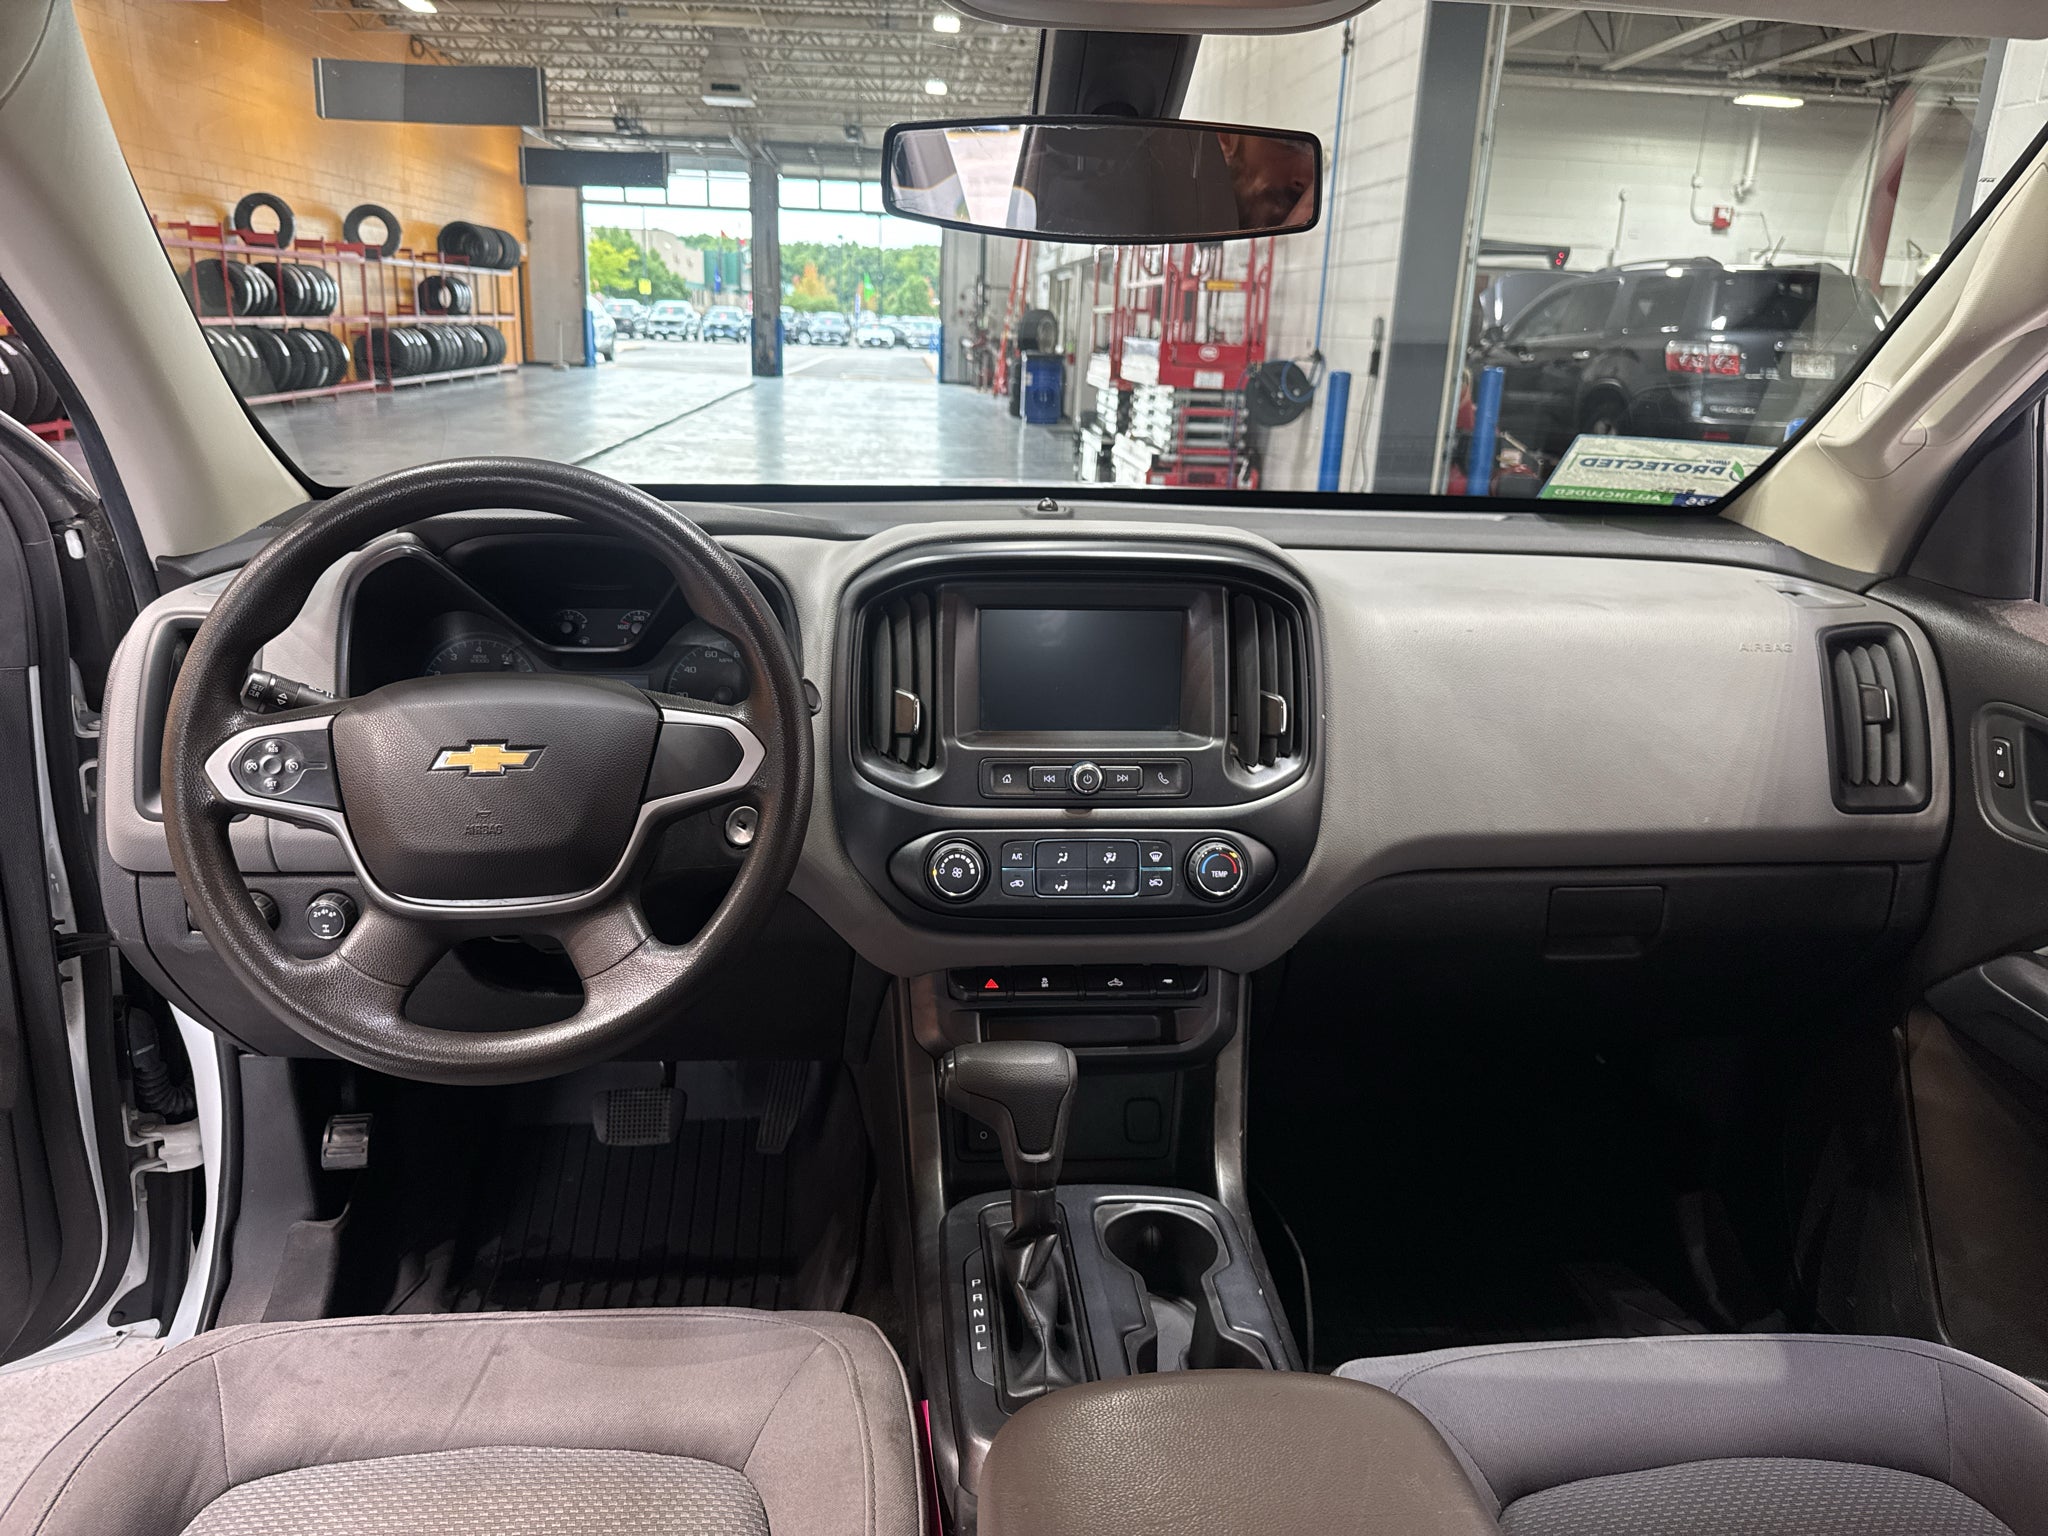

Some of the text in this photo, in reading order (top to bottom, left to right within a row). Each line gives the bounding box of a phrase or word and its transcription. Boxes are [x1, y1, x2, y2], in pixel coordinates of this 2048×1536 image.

[1739, 643, 1793, 653] AIRBAG
[451, 653, 458, 661] 3
[704, 650, 718, 658] 60
[248, 690, 260, 698] CLR
[465, 823, 503, 836] AIRBAG
[1011, 852, 1023, 861] A/C
[1211, 870, 1228, 878] TEMP
[971, 1279, 981, 1287] P
[972, 1293, 983, 1303] R
[973, 1308, 984, 1318] N
[975, 1324, 986, 1334] D
[976, 1342, 987, 1351] L
